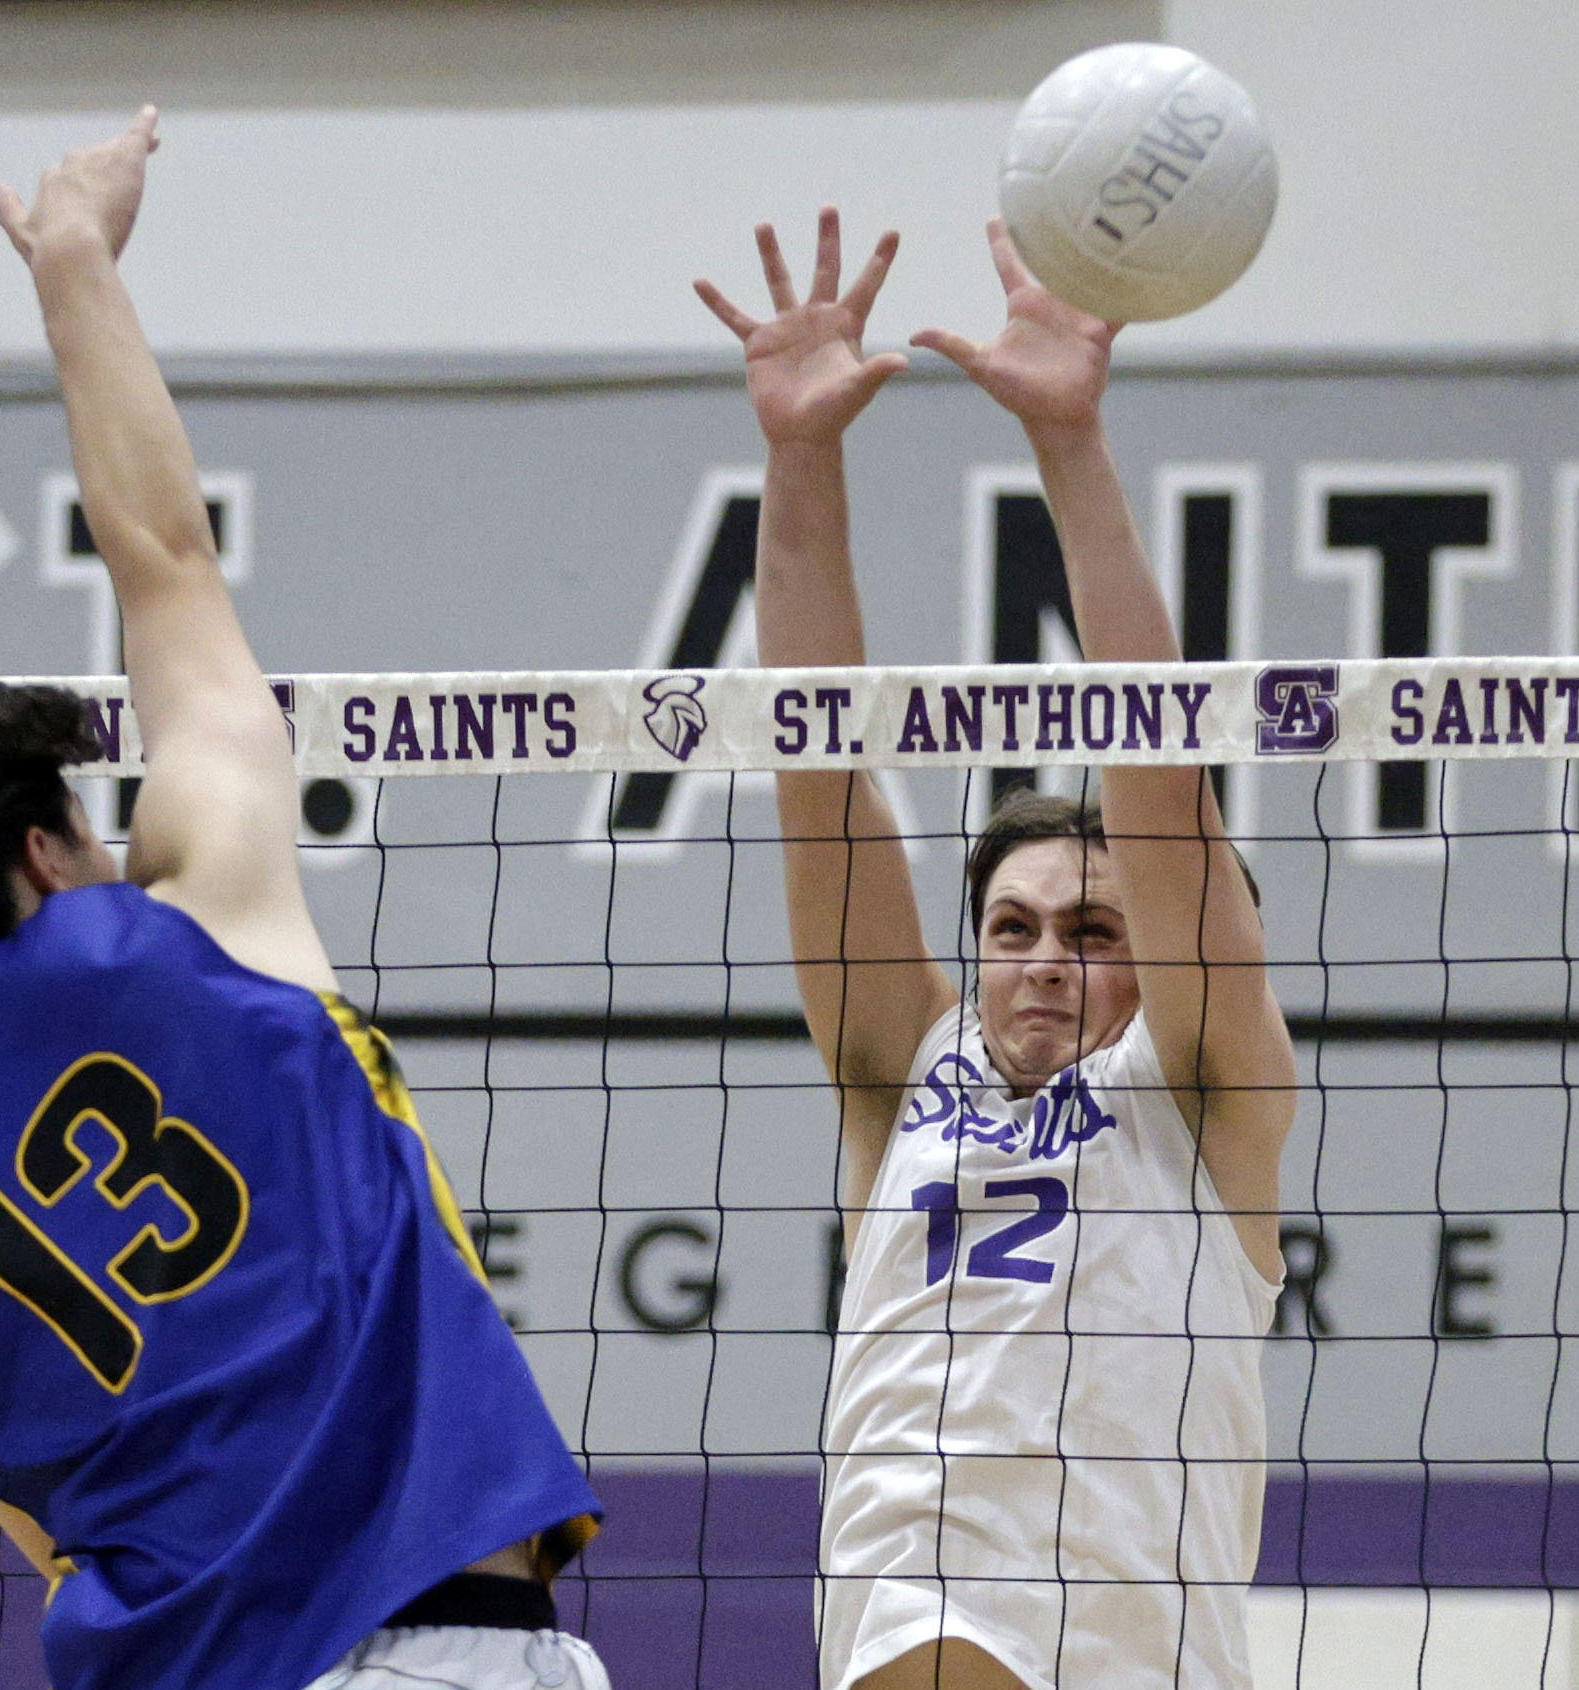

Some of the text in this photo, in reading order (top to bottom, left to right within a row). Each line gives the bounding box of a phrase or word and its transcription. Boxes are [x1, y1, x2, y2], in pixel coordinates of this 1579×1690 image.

[1098, 91, 1223, 227] SAHS
[344, 692, 576, 762] SAINTS
[774, 688, 863, 755] ST.
[897, 682, 1211, 753] ANTHONY
[911, 1176, 1069, 1287] 12
